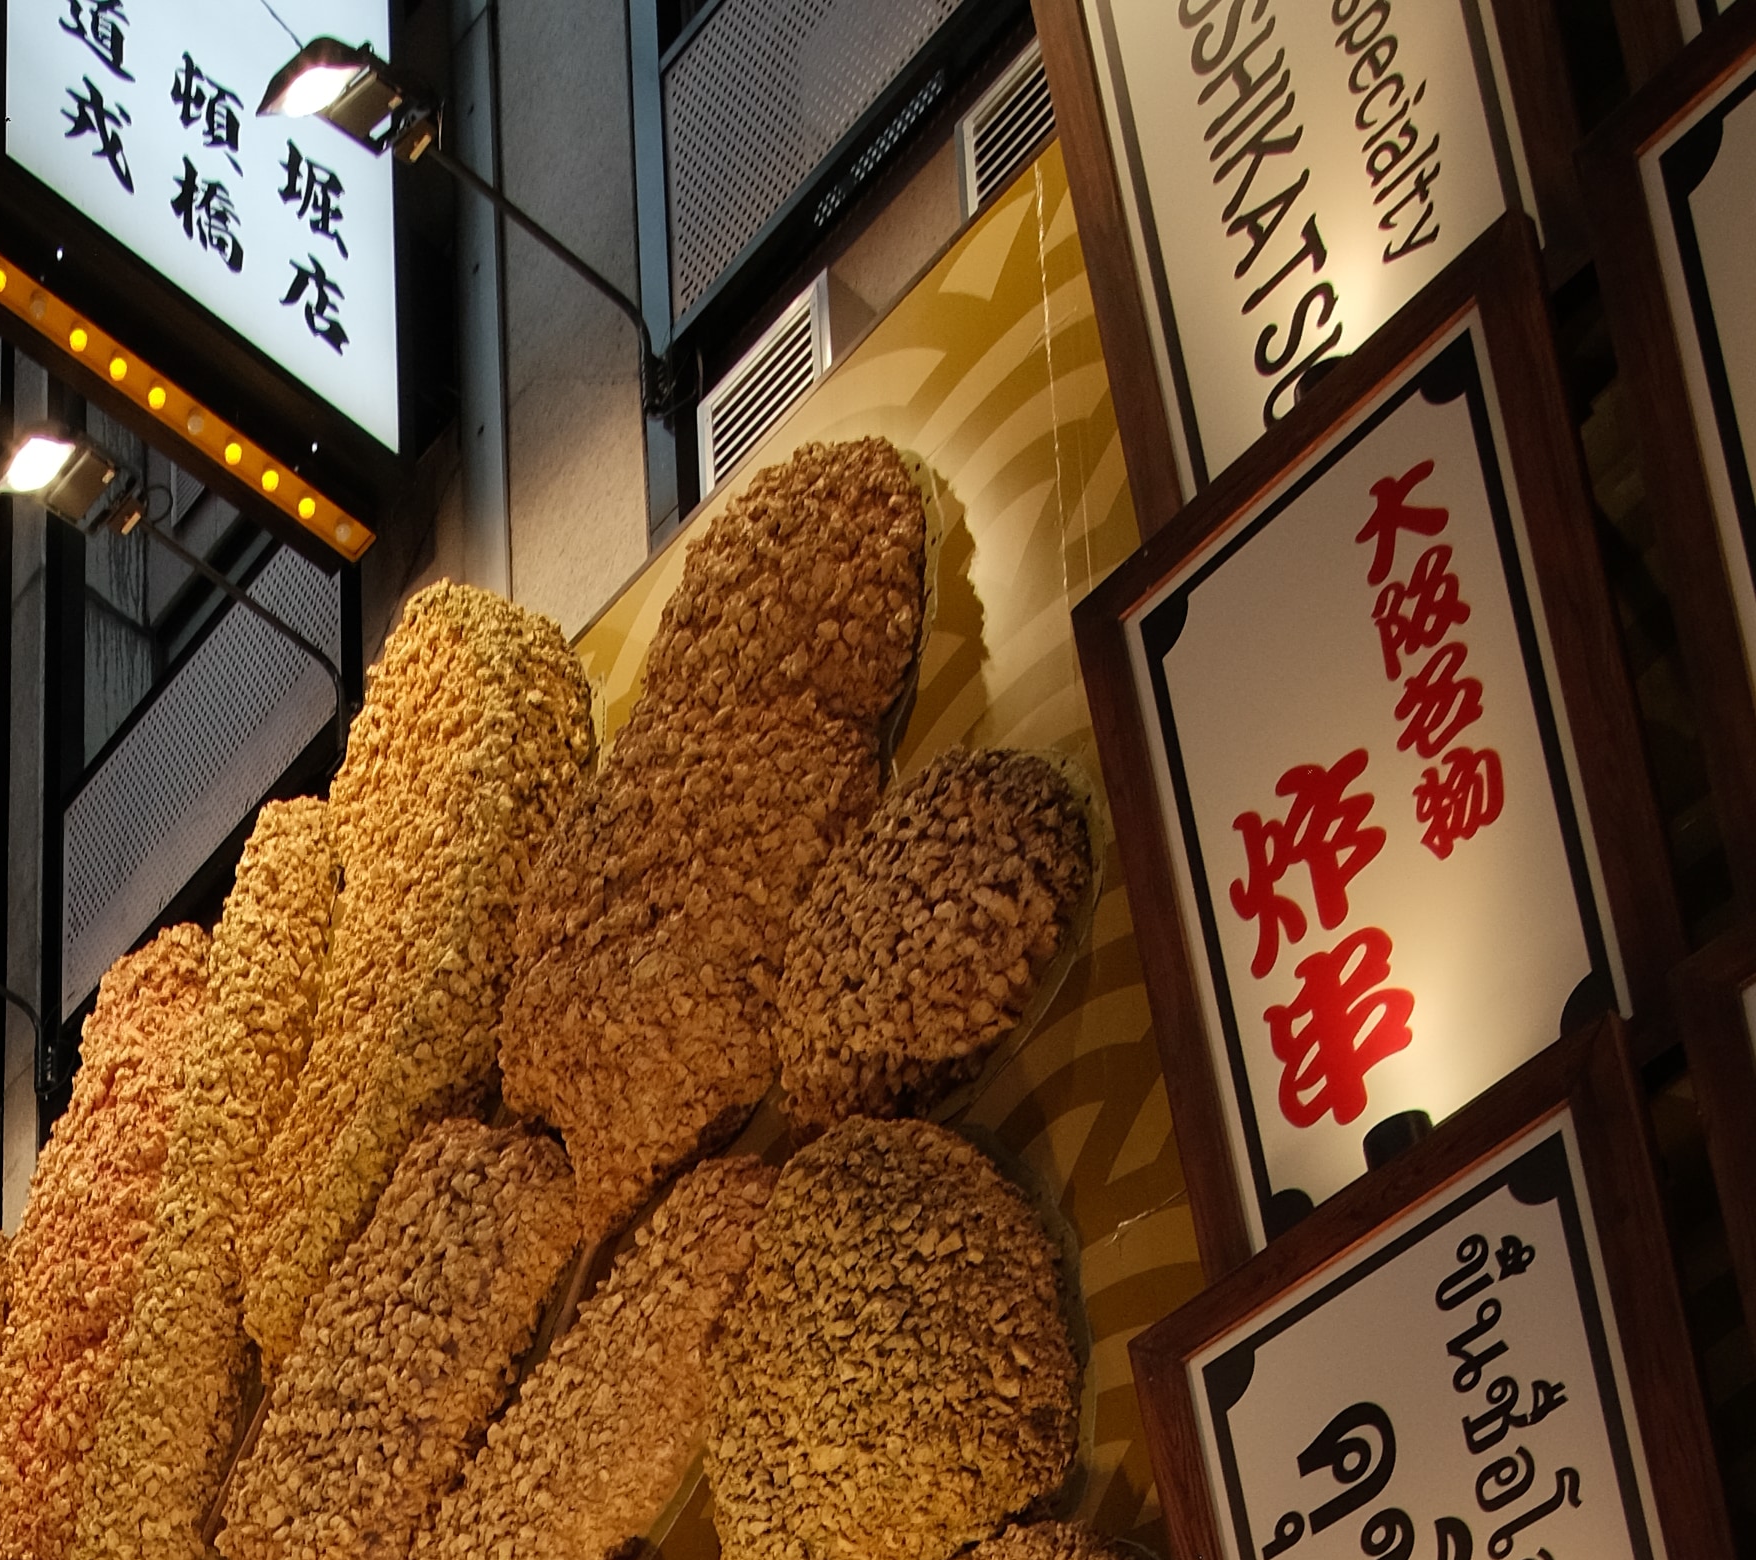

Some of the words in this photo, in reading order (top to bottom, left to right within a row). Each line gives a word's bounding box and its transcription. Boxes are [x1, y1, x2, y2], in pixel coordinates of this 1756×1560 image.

[1179, 0, 1343, 430] SHIKATSU
[1355, 459, 1504, 860] 大阪名物
[1230, 748, 1415, 1128] 炸串
